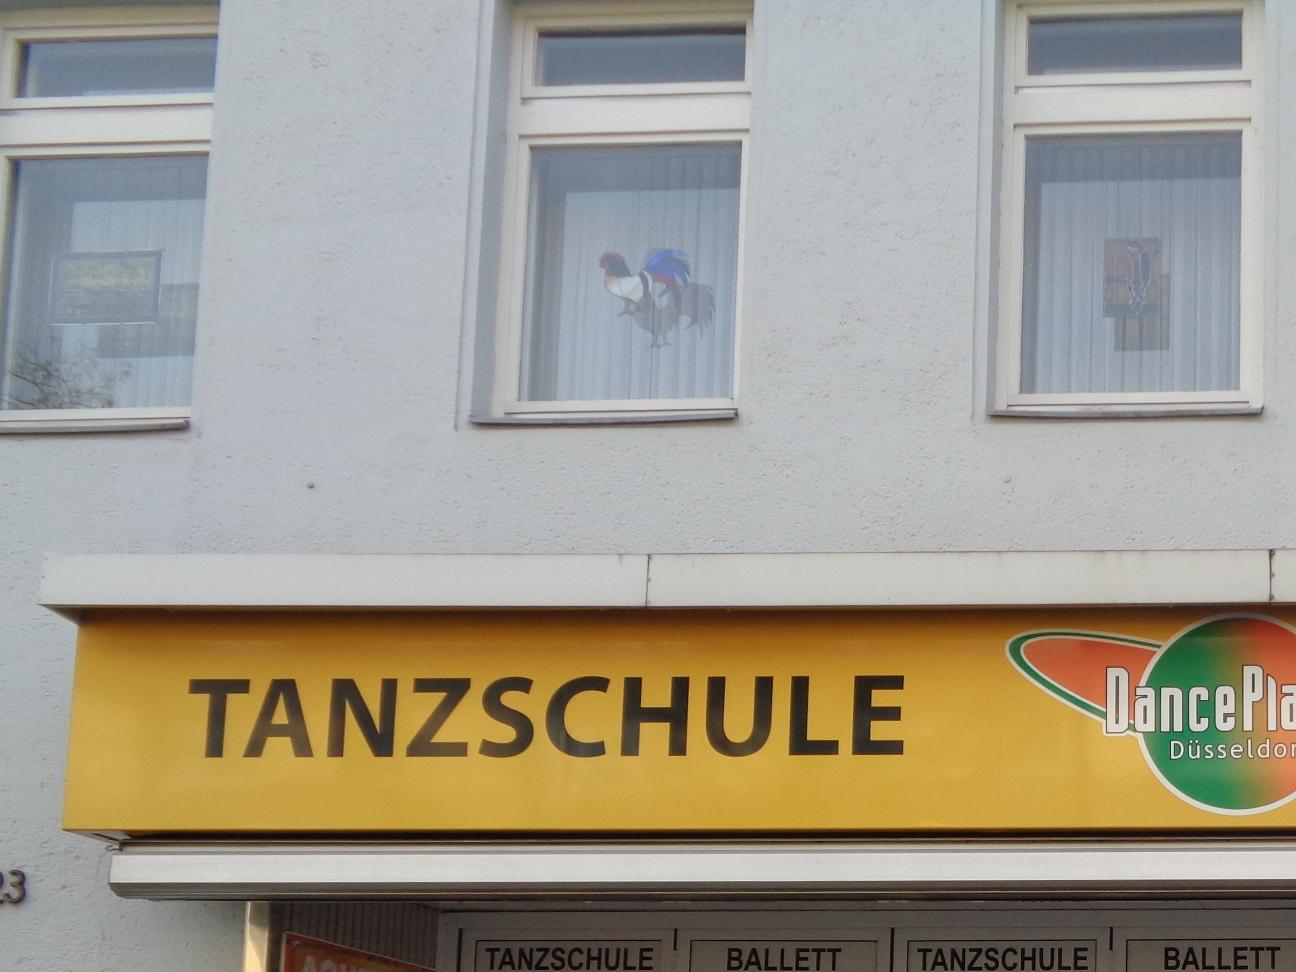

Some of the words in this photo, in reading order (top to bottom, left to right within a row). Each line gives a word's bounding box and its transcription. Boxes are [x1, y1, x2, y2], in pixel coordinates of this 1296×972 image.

[189, 675, 904, 759] TANZSCHULE
[0, 870, 26, 904] 3
[486, 947, 653, 971] TANZSCHULE
[727, 948, 842, 971] BALLETT
[917, 947, 1088, 971] TANZSCHULE
[1164, 947, 1280, 970] BALLETT
